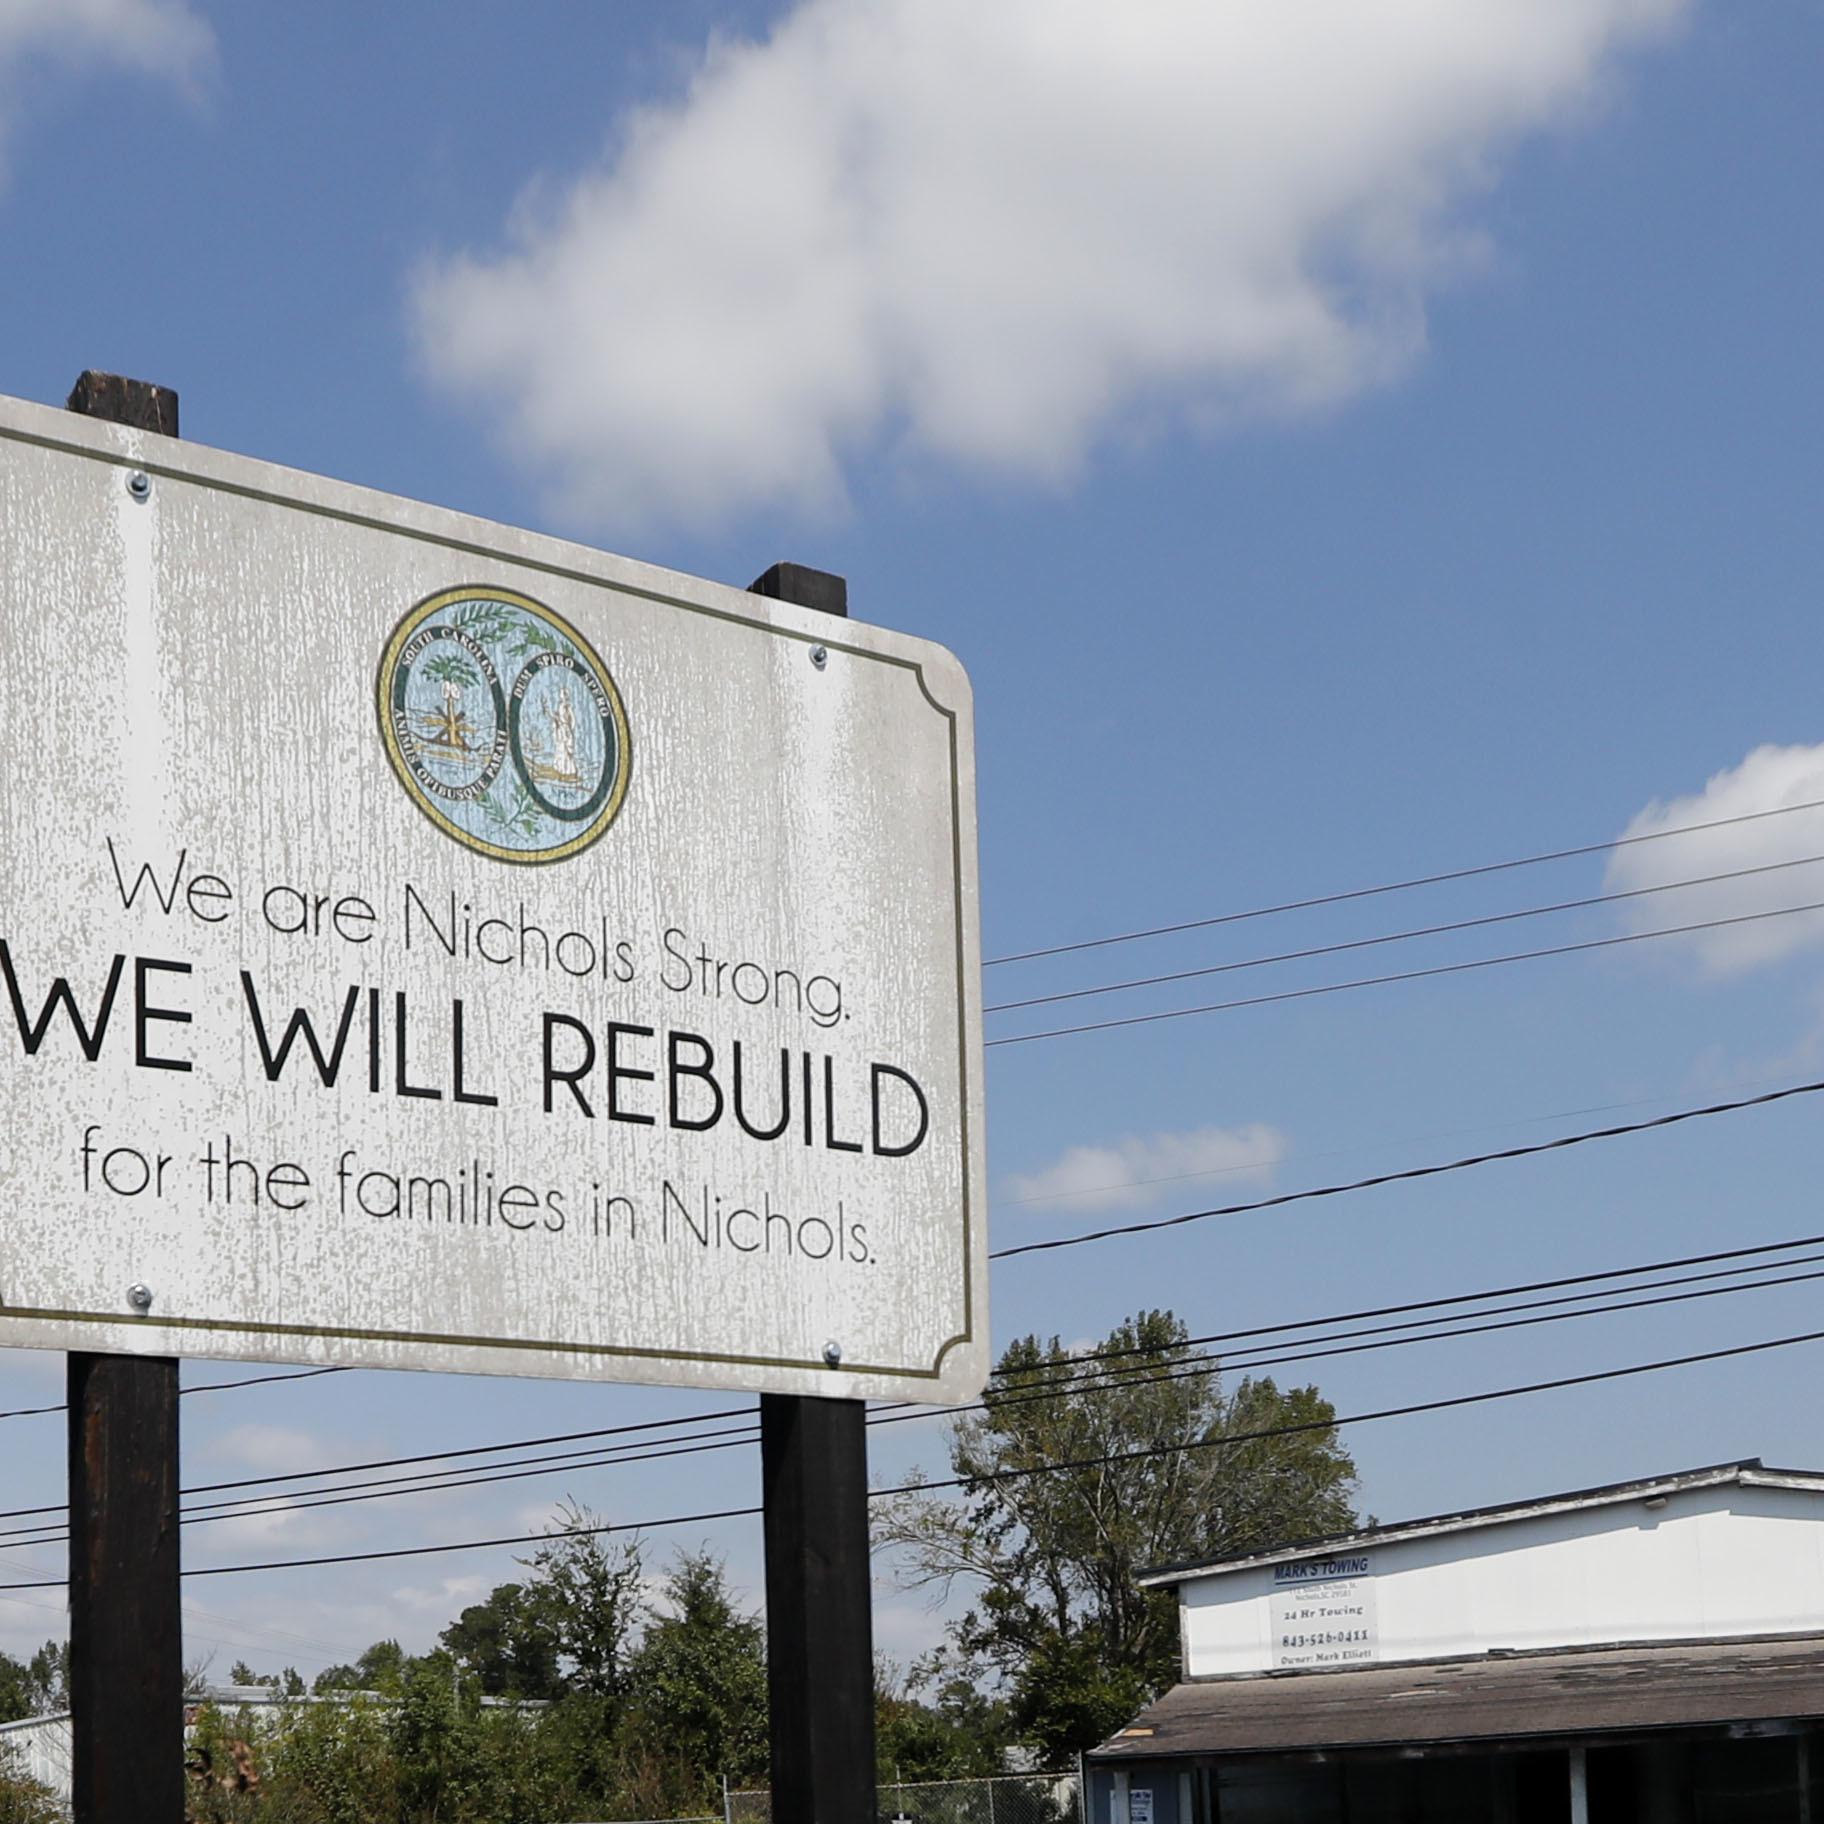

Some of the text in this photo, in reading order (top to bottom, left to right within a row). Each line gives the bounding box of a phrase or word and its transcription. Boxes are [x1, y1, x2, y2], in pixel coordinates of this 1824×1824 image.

[402, 627, 498, 685] SOUTH CAROLINA
[513, 653, 611, 719] DUM SPIRO SPERO
[394, 707, 507, 800] ANIMIS OPIBUSQUE PARATI
[106, 833, 851, 1028] We are Nichols Strong.
[239, 970, 499, 1107] WILL
[543, 1011, 928, 1158] REBUILD
[80, 1125, 876, 1264] for the families in Nichols.
[1274, 1557, 1369, 1580] MARK'S TOWING
[1282, 1629, 1369, 1648] 843-526-0411
[1284, 1605, 1364, 1620] 24 Hr Towing
[1281, 1655, 1314, 1665] Owner:
[1316, 1651, 1339, 1663] Mark
